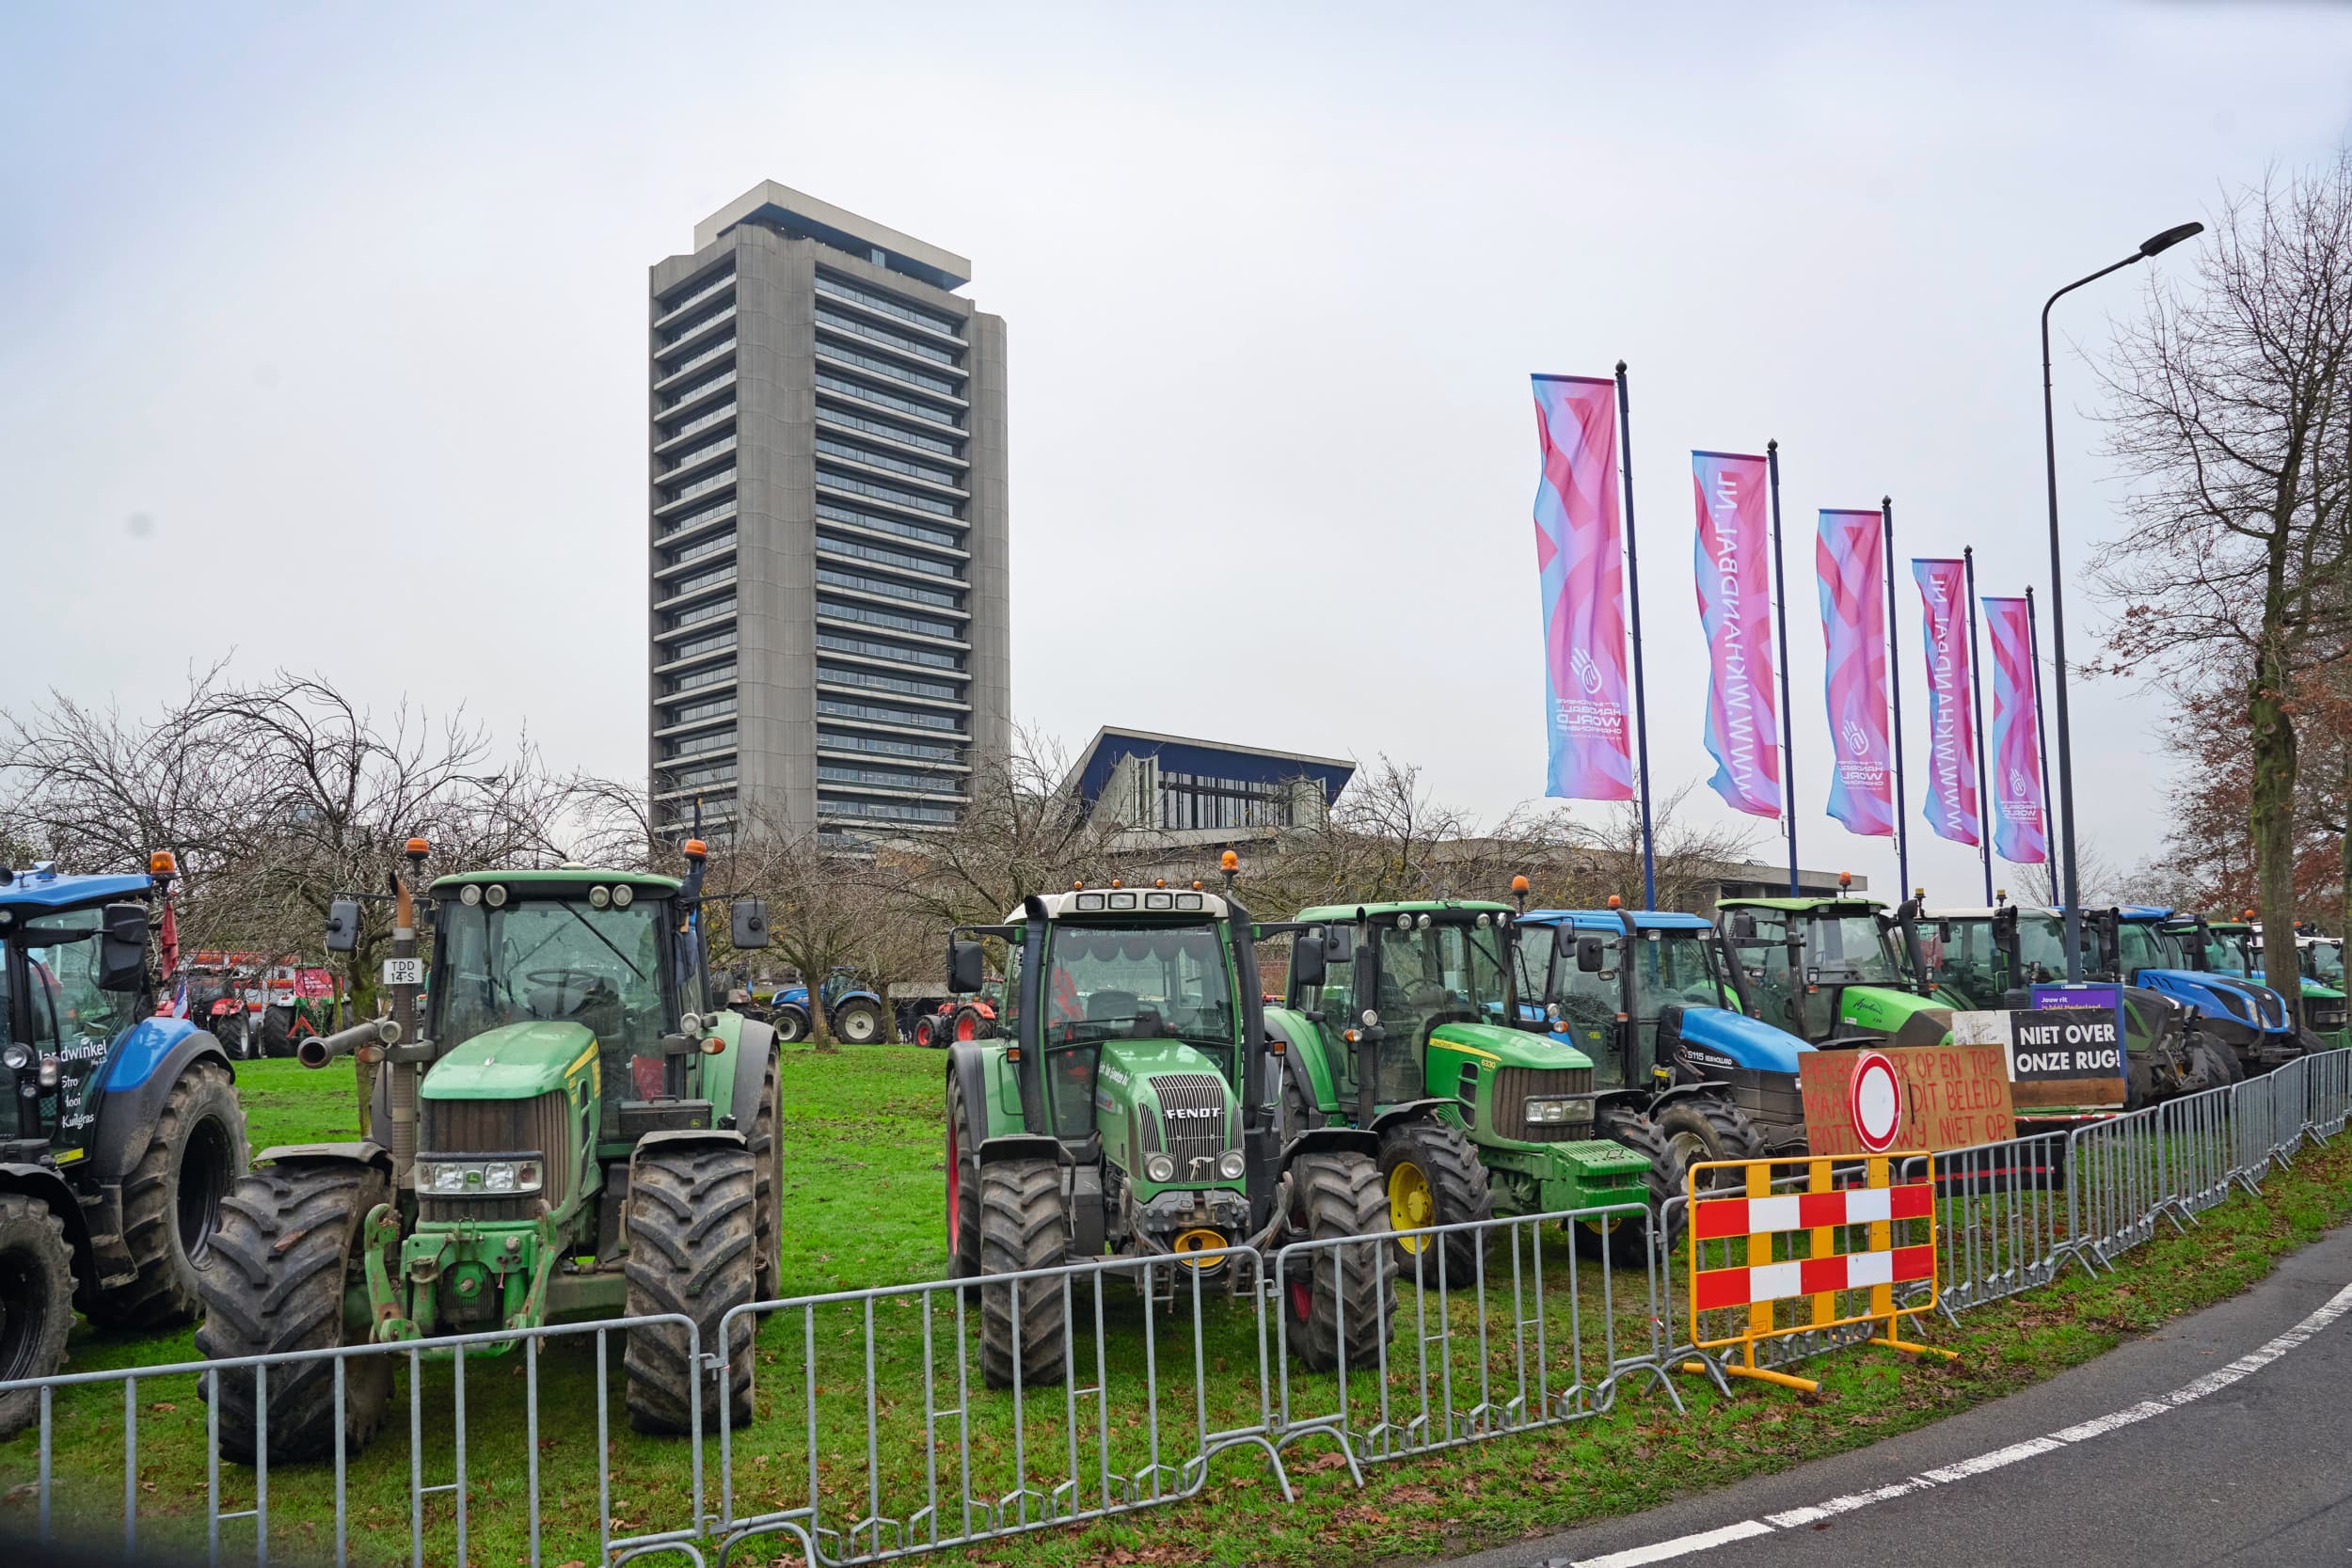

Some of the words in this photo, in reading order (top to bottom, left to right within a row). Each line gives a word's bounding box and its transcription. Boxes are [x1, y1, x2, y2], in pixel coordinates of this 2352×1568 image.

[391, 961, 414, 971] TDD
[2020, 1026, 2059, 1045] NIET
[2065, 1024, 2116, 1044] OVER
[1915, 1053, 1935, 1078] OP
[1940, 1053, 1961, 1078] EN
[1968, 1049, 2000, 1076] TOP
[2016, 1052, 2071, 1072] ONZE
[2075, 1049, 2121, 1069] RUG!
[61, 1075, 79, 1088] Stro
[1946, 1078, 2003, 1111] BELEID
[61, 1114, 94, 1129] Kuilgras
[1166, 1108, 1221, 1119] FENDT
[1810, 1124, 1856, 1155] ROTT
